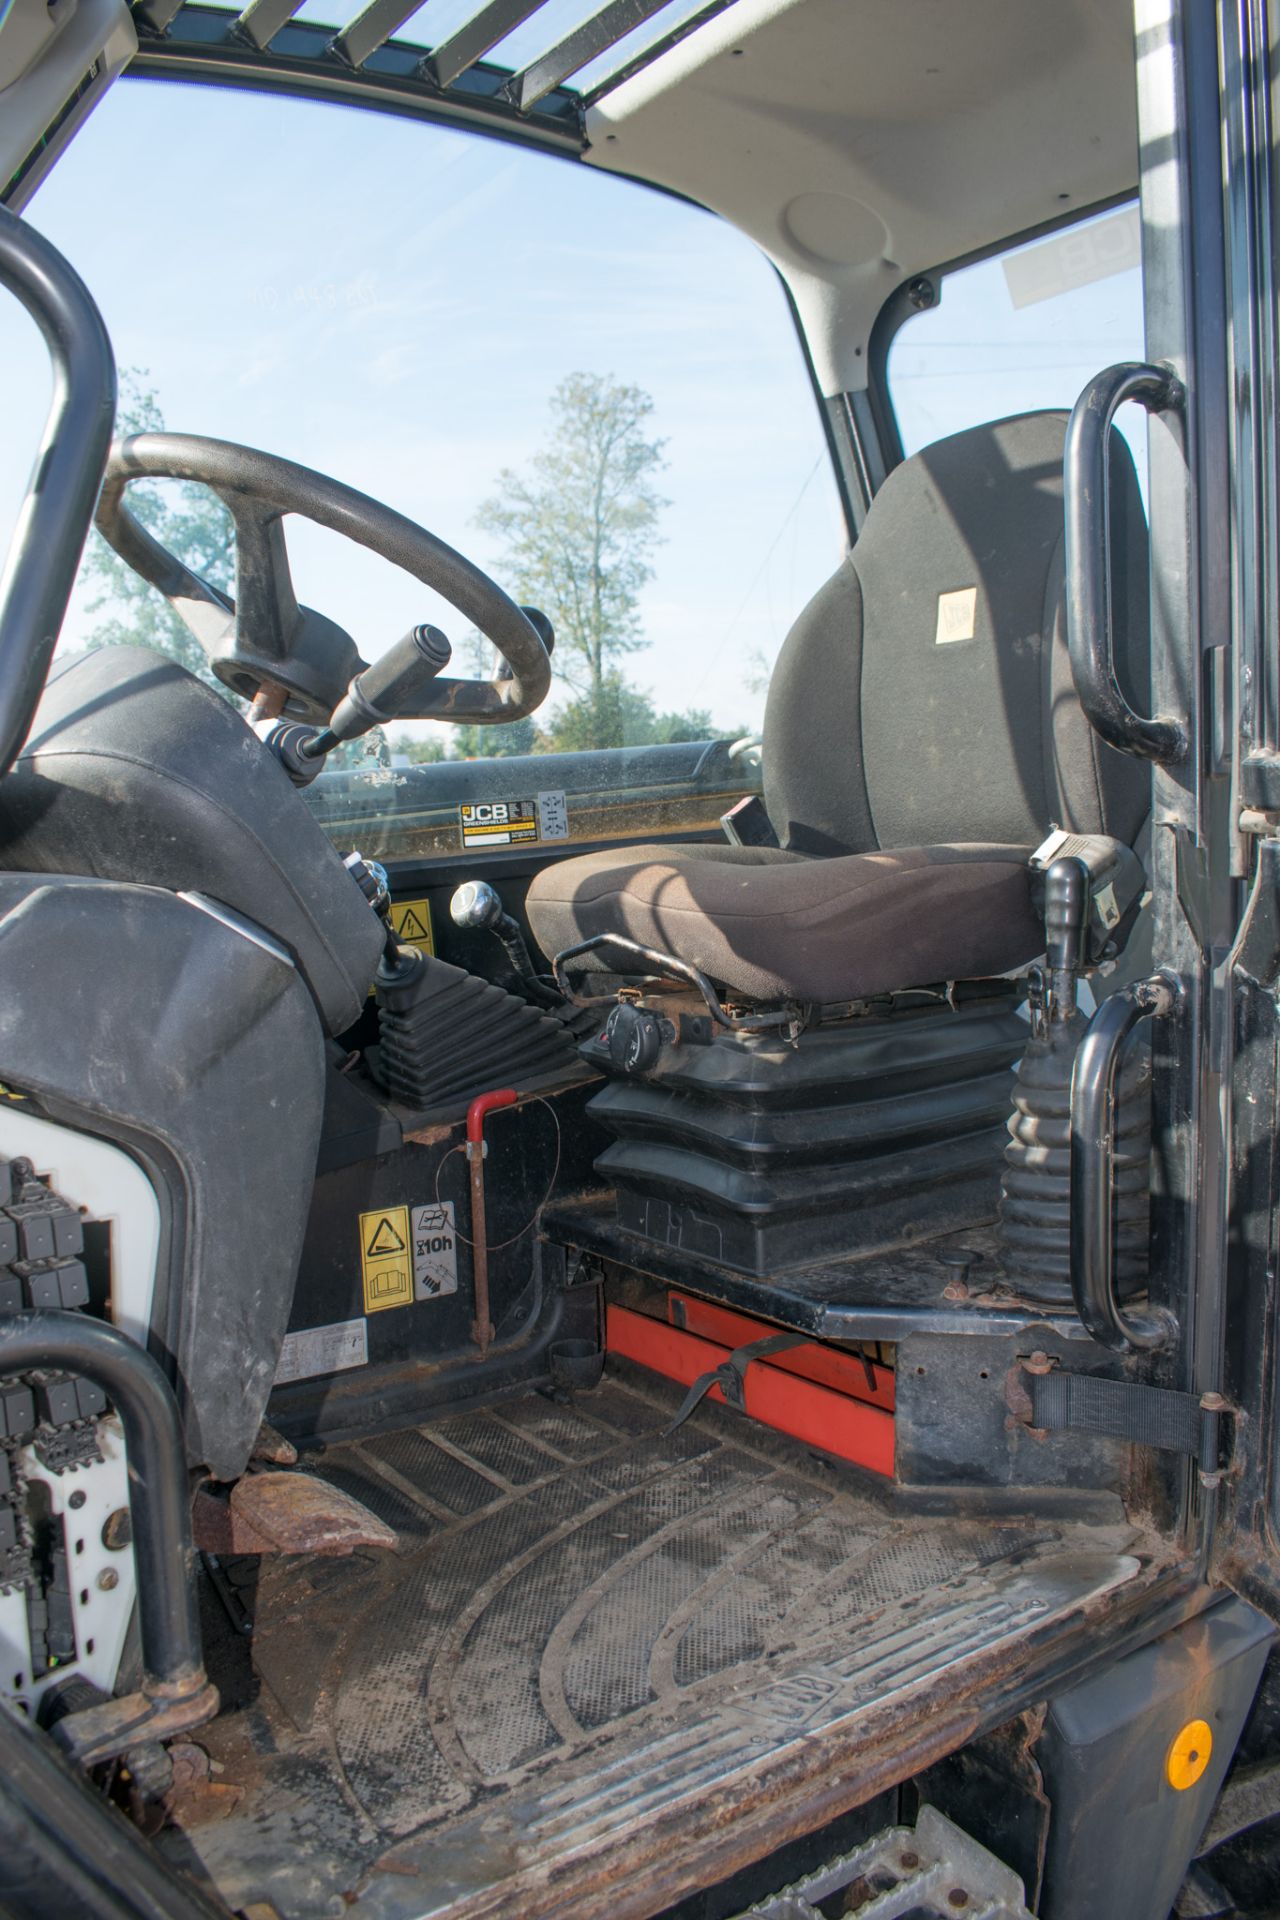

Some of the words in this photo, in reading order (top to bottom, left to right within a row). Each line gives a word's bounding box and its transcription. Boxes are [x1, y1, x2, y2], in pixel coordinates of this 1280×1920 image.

[462, 804, 508, 821] JCB
[424, 1236, 452, 1254] 10h
[750, 1676, 835, 1721] JCB
